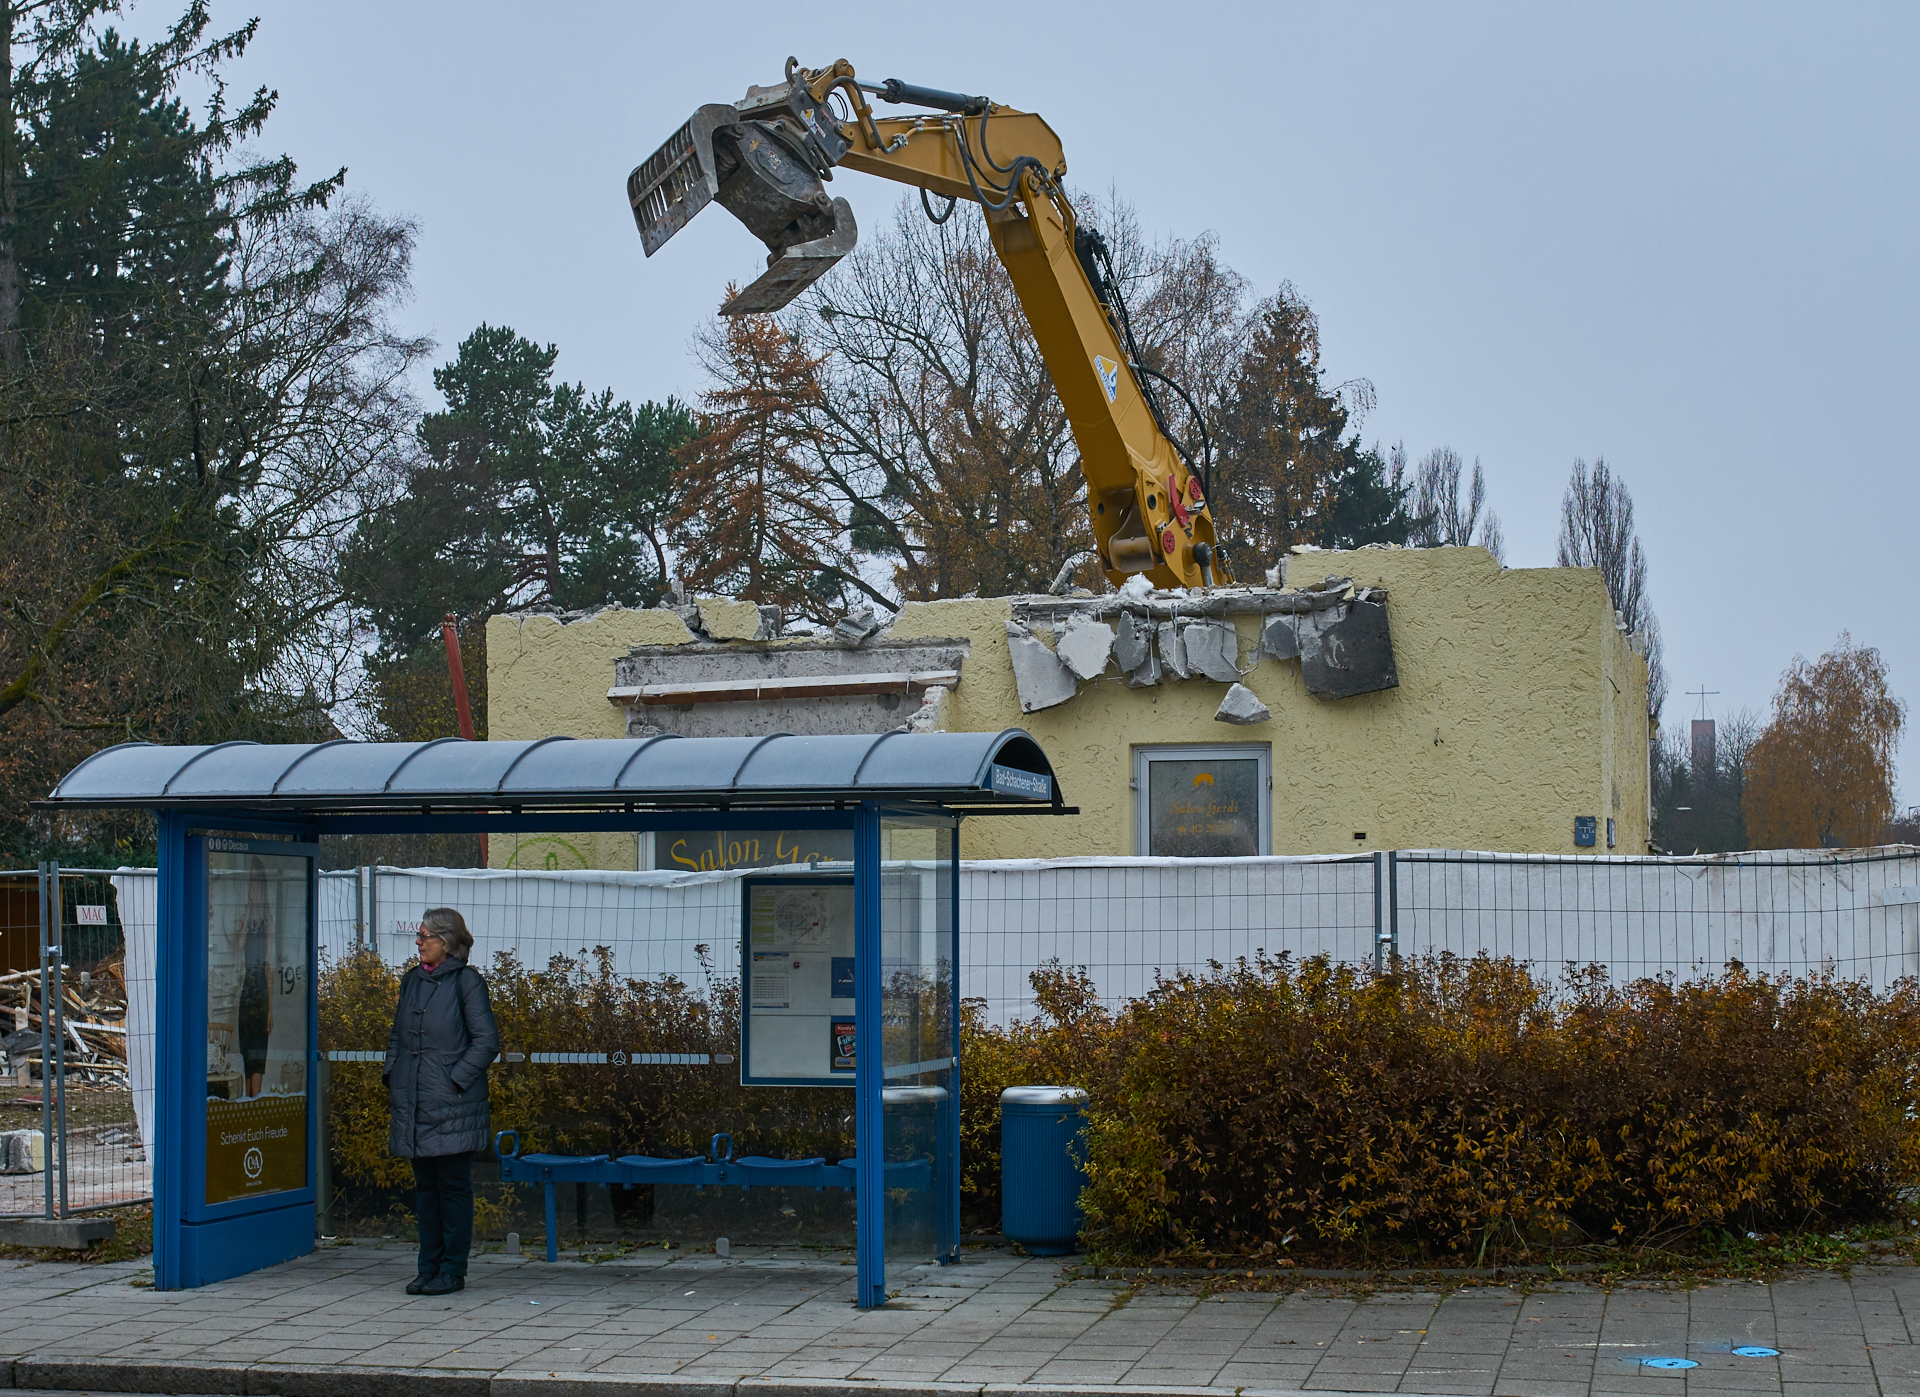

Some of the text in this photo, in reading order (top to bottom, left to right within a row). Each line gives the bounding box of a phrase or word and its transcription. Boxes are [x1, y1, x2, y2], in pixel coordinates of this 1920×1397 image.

[996, 769, 1046, 794] Bad-Schachener-Straße
[1169, 799, 1238, 817] Salon Gerdi
[82, 907, 105, 921] MAC
[221, 1125, 288, 1146] Schenkt Euch Freude
